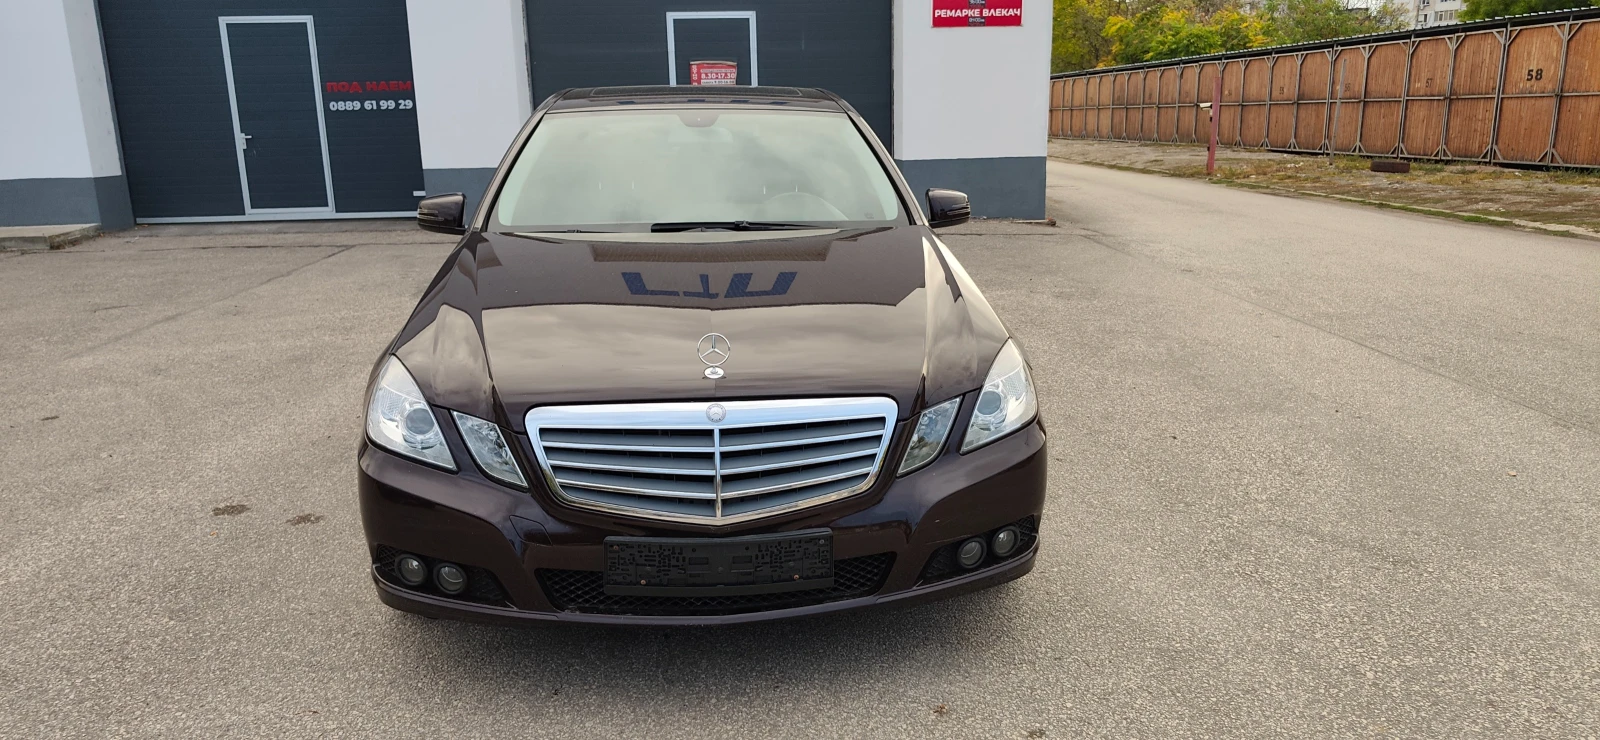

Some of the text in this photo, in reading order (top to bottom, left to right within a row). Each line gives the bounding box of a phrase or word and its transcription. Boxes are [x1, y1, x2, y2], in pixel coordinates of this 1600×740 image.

[935, 8, 1021, 18] РЕМАРКЕ ВЛЕКАЧ
[1526, 68, 1543, 81] 58
[326, 81, 412, 93] ПОД НАЕМ
[1425, 78, 1433, 88] 57
[329, 99, 413, 111] 0889 61 99 29
